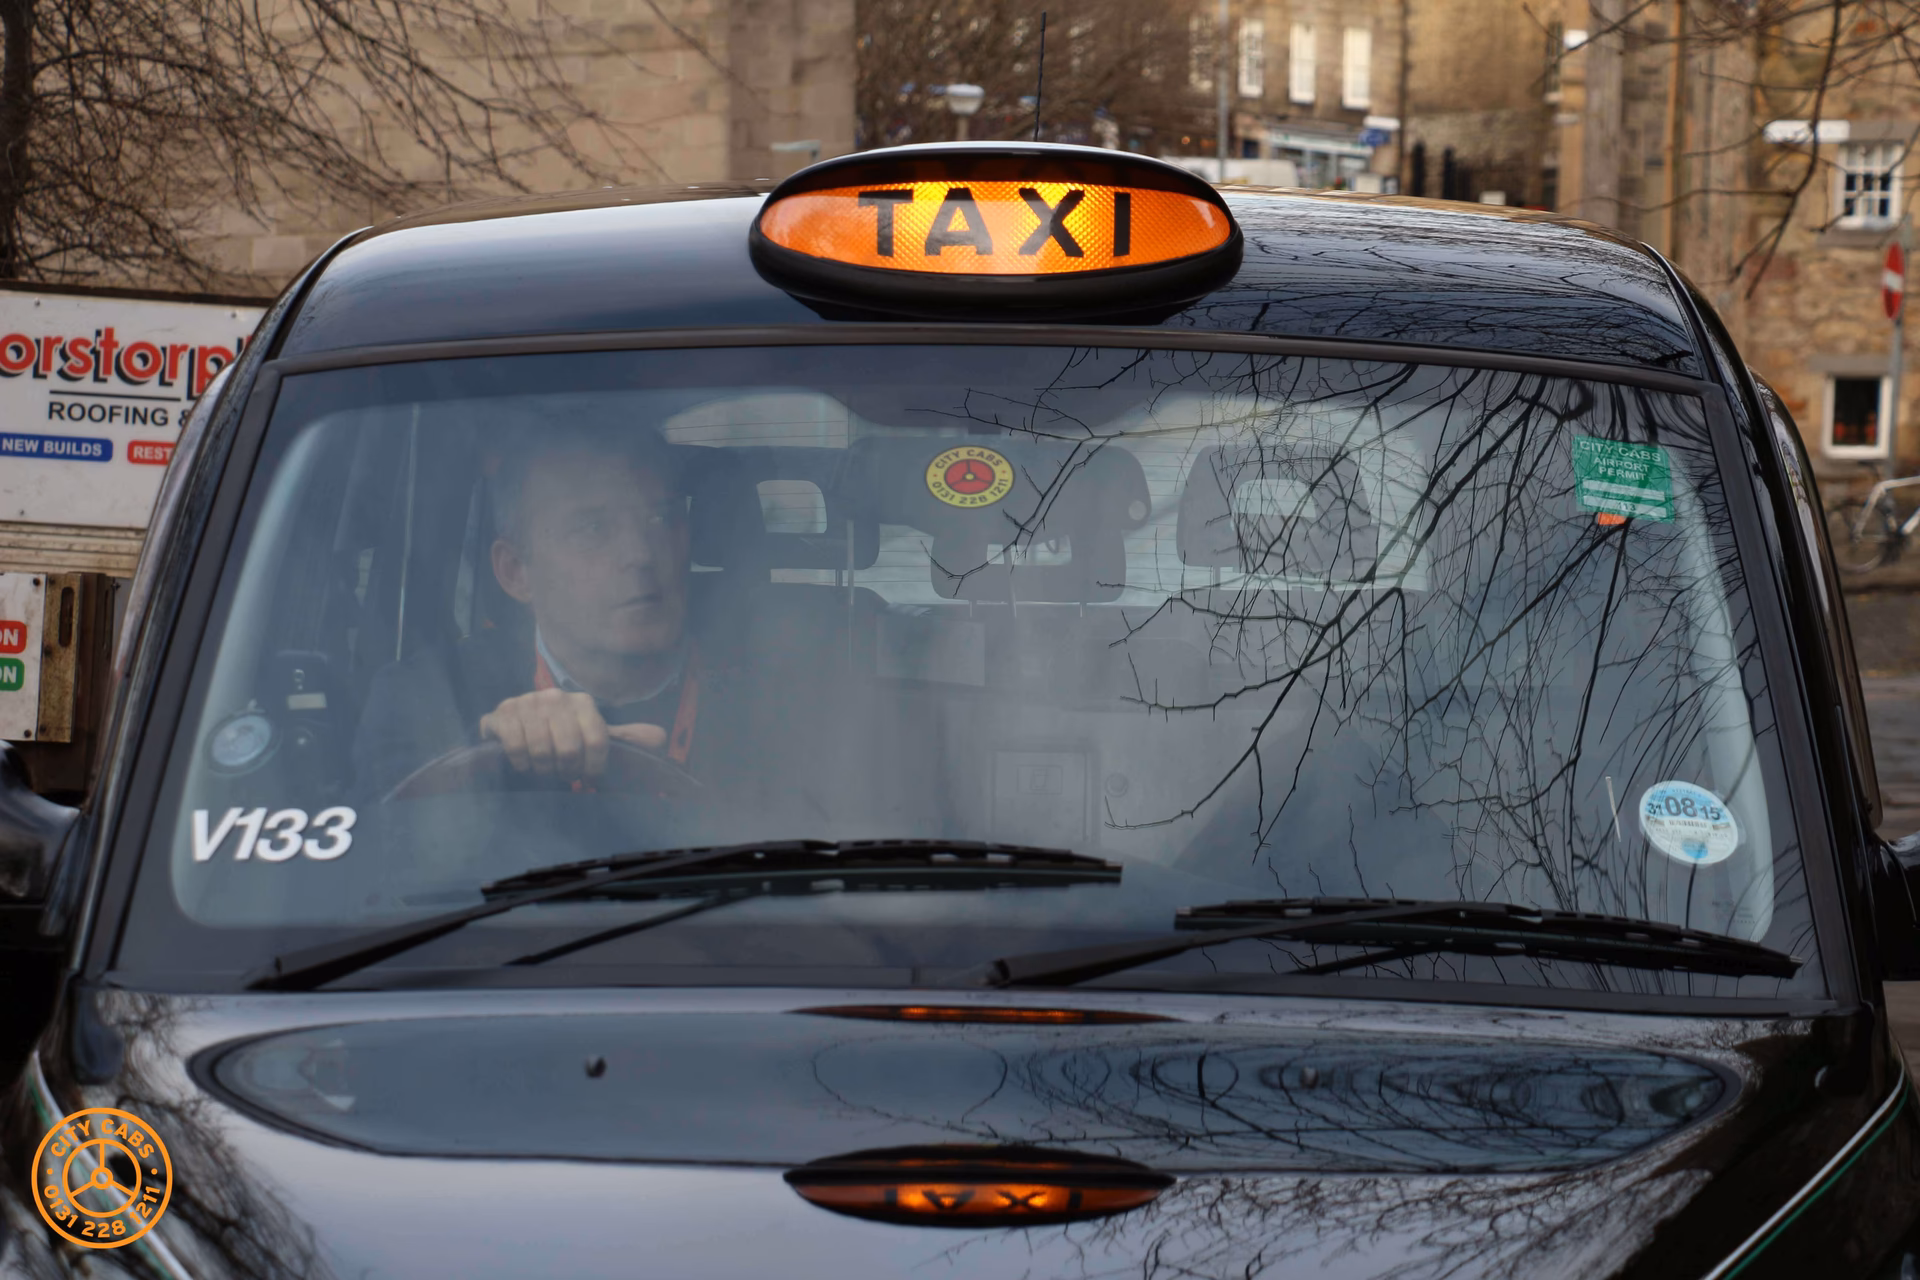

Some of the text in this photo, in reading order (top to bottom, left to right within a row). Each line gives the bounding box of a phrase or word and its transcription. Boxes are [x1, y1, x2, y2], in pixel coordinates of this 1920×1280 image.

[858, 187, 1131, 258] TAXI
[0, 327, 252, 399] orstorp
[48, 402, 168, 427] ROOFING
[2, 438, 102, 456] NEW BUILDS
[1580, 441, 1660, 462] CITY CABS
[934, 449, 1003, 469] CITY CABS
[1594, 457, 1650, 473] AIRPORT
[1599, 466, 1647, 480] PERMIT
[932, 481, 955, 501] 0131
[1647, 796, 1721, 821] 31 08 15
[193, 806, 357, 861] V133
